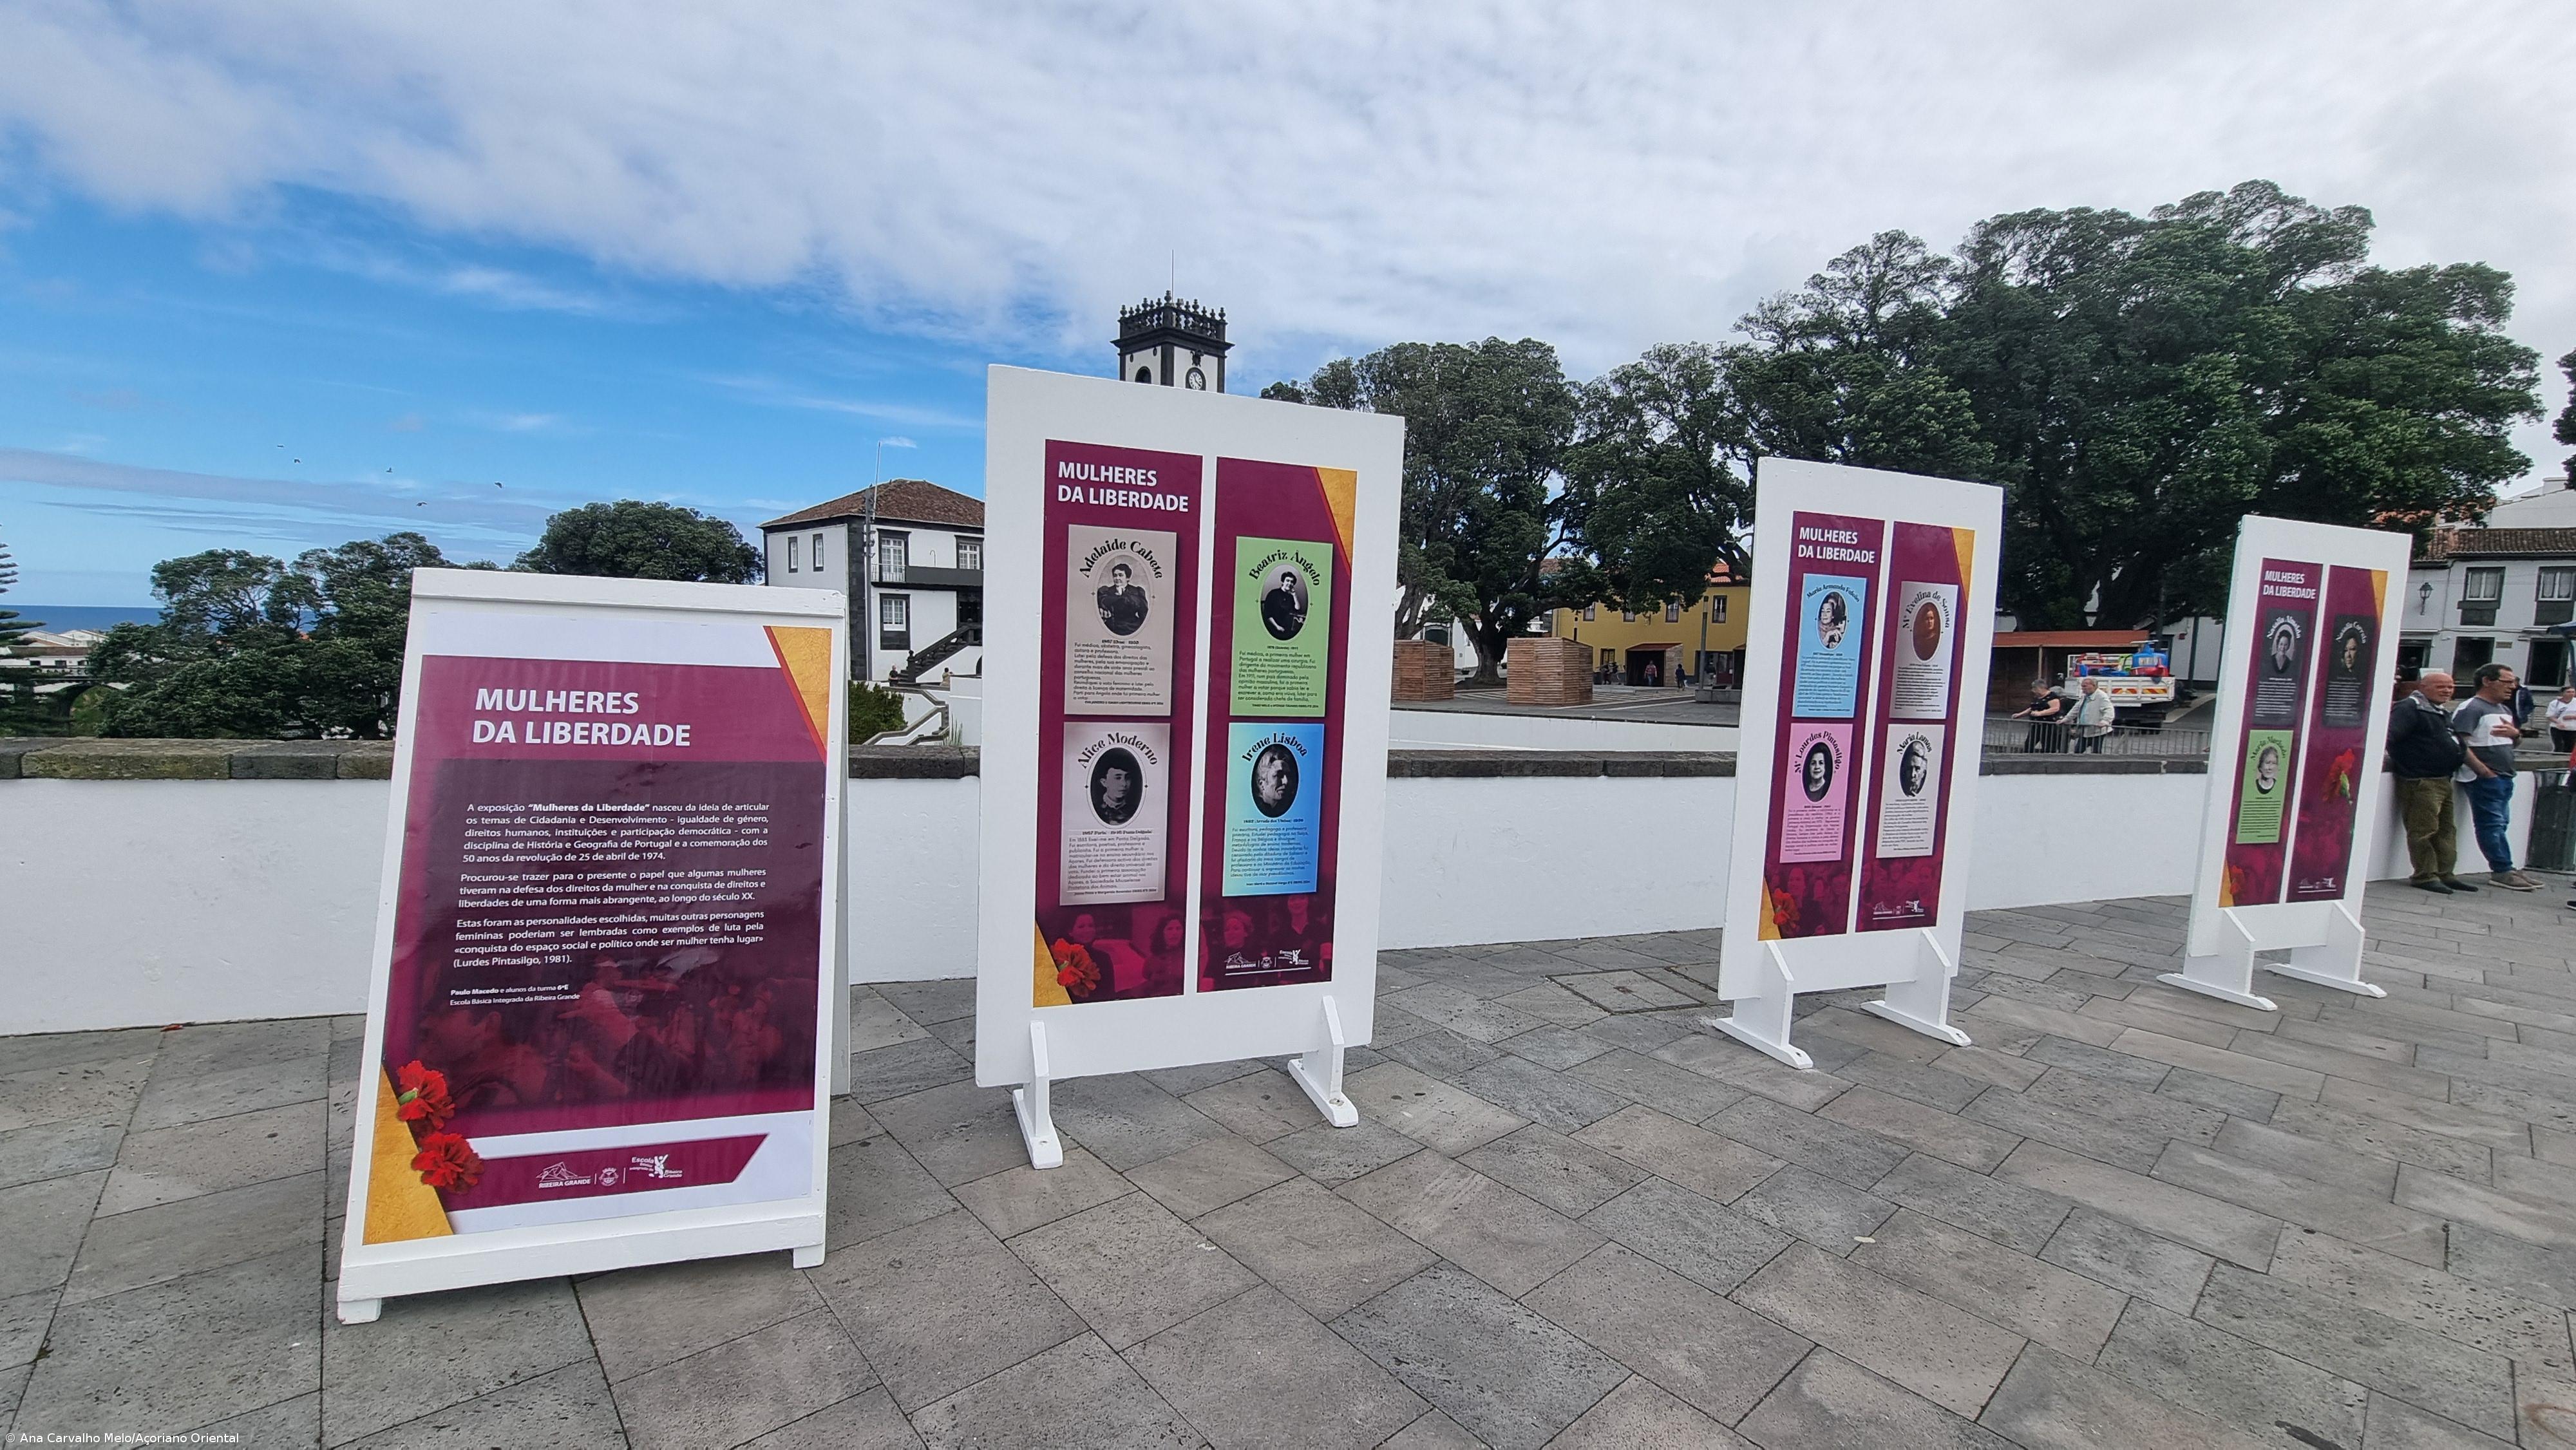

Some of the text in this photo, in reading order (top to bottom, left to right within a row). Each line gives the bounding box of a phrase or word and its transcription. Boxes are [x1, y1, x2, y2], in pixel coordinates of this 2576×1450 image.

[1058, 461, 1157, 487] MULHERES
[1058, 485, 1189, 513] DA LIBERDADE
[1799, 527, 1858, 544] MULHERES
[1079, 538, 1164, 579] Adelaide Cabete
[1798, 545, 1875, 563] DA LIBERDADE
[1249, 549, 1320, 586] Beatriz Ângelo
[2264, 570, 2305, 584] MULHERES
[1932, 590, 1941, 601] de
[2263, 585, 2316, 599] DA LIBERDADE
[475, 688, 639, 714] MULHERES
[473, 720, 690, 746] DA LIBERDADE
[1077, 732, 1158, 769] Alice Moderno
[1242, 733, 1309, 762] Irene Lisboa
[477, 804, 526, 813] exposição
[581, 803, 594, 811] da
[685, 803, 696, 811] da
[699, 803, 719, 811] ideia
[721, 803, 733, 811] de
[514, 816, 526, 824] de
[529, 816, 576, 824] Cidadania
[589, 815, 667, 824] Desenvolvimento
[677, 815, 720, 825] igualdade
[723, 814, 734, 823] de
[737, 814, 769, 825] género,
[464, 829, 501, 837] direitos
[505, 829, 551, 837] humanos,
[555, 828, 608, 838] instituições
[620, 827, 675, 838] participação
[678, 827, 732, 835] democrática
[502, 854, 515, 862] da
[516, 853, 563, 863] revolução
[564, 852, 577, 861] de
[592, 852, 604, 861] de
[605, 852, 626, 860] abril
[628, 852, 640, 860] de
[460, 874, 519, 882] Procurou-se
[553, 874, 574, 882] para
[587, 872, 627, 881] presente
[639, 870, 665, 880] papel
[667, 871, 685, 880] que
[687, 869, 724, 880] algumas
[727, 868, 766, 876] mulheres
[459, 898, 509, 908] liberdades
[511, 898, 524, 907] de
[549, 897, 577, 905] forma
[579, 896, 601, 905] mais
[602, 896, 657, 905] abrangente,
[672, 894, 697, 904] longo
[699, 893, 711, 901] do
[712, 892, 740, 901] século
[741, 892, 755, 900] XX.
[457, 919, 482, 928] Estas
[483, 918, 512, 927] foram
[526, 916, 598, 928] personalidades
[598, 914, 648, 923] escolhidas,
[650, 913, 679, 921] muitas
[710, 912, 764, 921] personagens
[455, 932, 504, 941] femininas
[508, 930, 555, 941] poderiam
[579, 927, 627, 936] lembradas
[662, 924, 705, 934] exemplos
[708, 923, 720, 932] de
[724, 923, 741, 931] luta
[745, 922, 764, 932] pela
[509, 943, 524, 952] do
[525, 944, 560, 953] espaço
[562, 941, 588, 950] social
[598, 939, 634, 950] político
[635, 938, 659, 947] onde
[676, 936, 708, 946] mulher
[709, 935, 735, 944] tenha
[453, 954, 573, 968] (Lurdes Pintasilgo, 1981).
